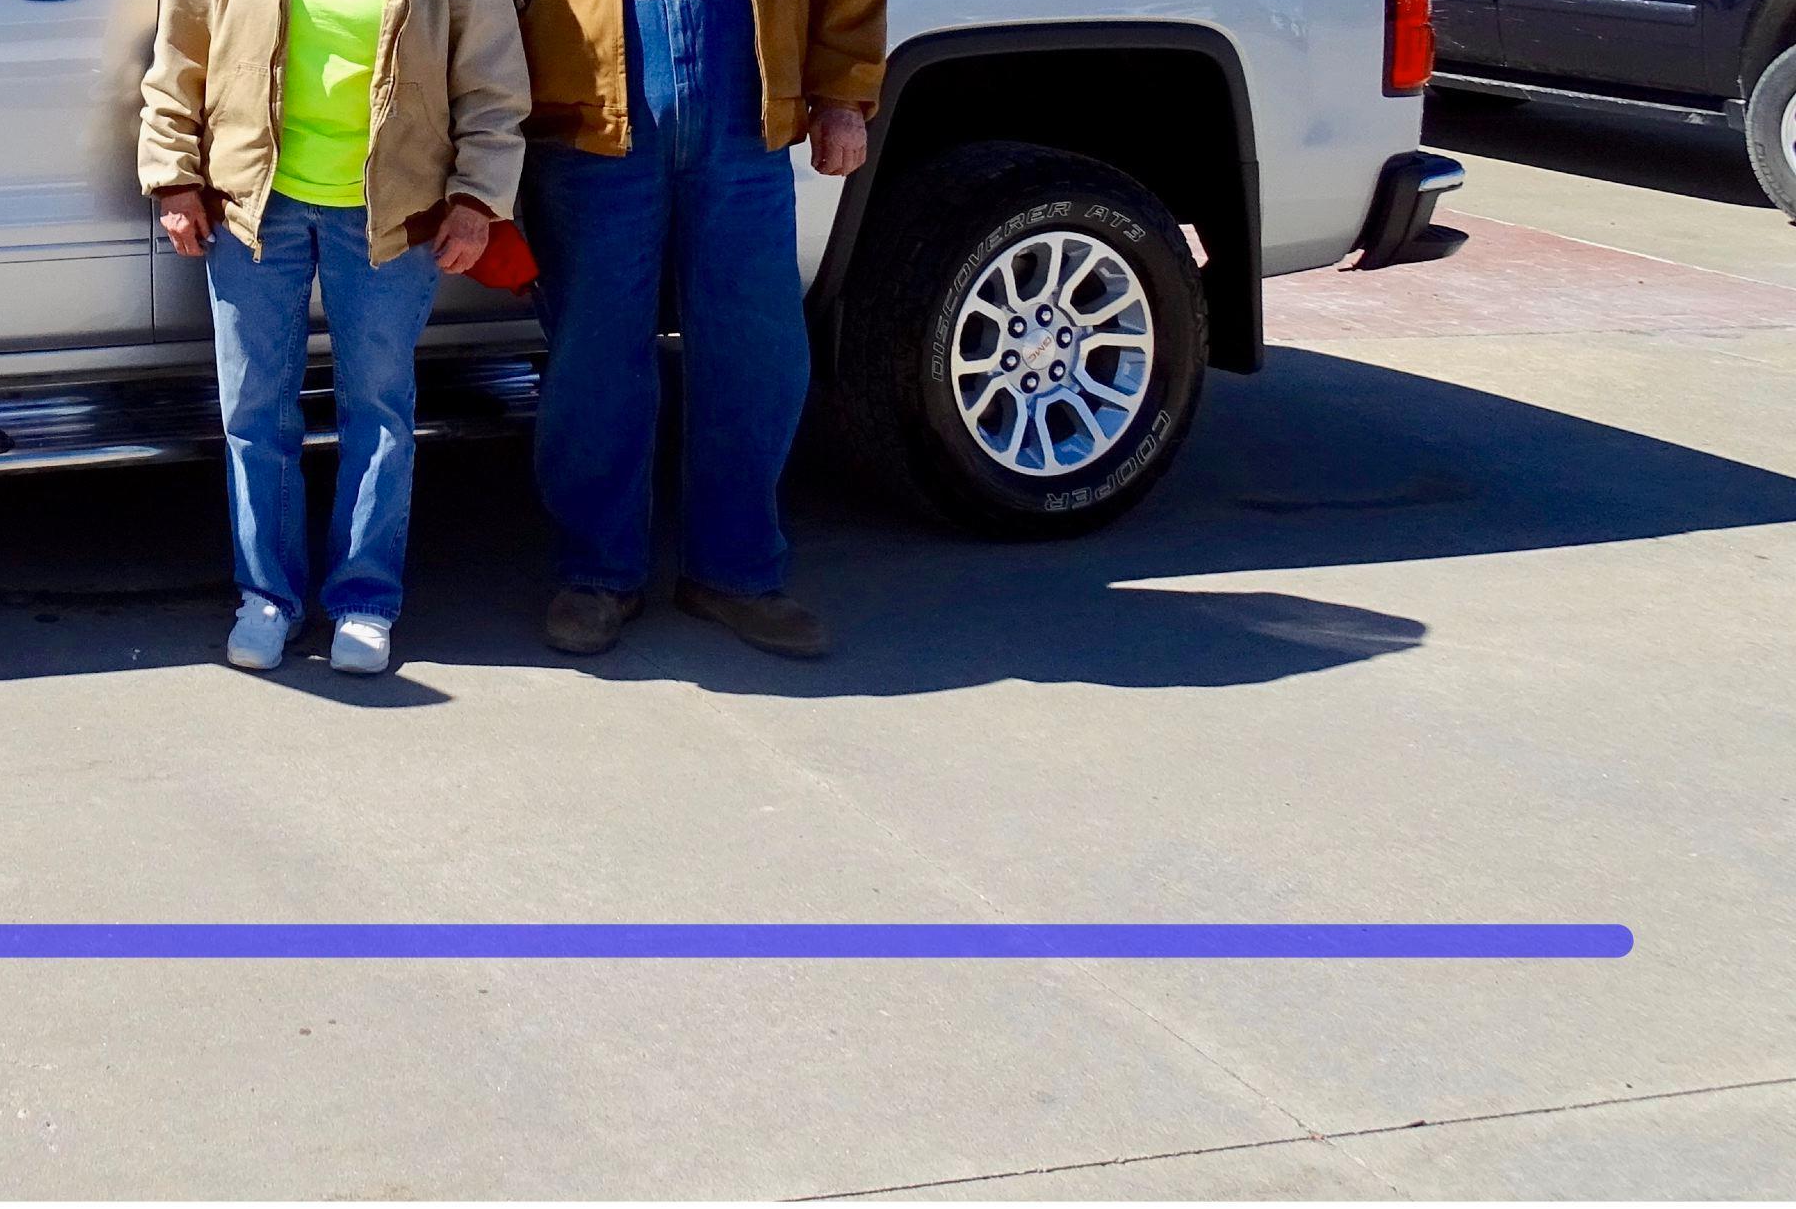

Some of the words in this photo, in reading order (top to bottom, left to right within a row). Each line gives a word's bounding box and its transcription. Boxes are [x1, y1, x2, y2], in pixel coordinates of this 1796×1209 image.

[931, 201, 1072, 383] DISCOVERER
[1084, 204, 1147, 243] AT3
[1044, 409, 1172, 512] COOPER
